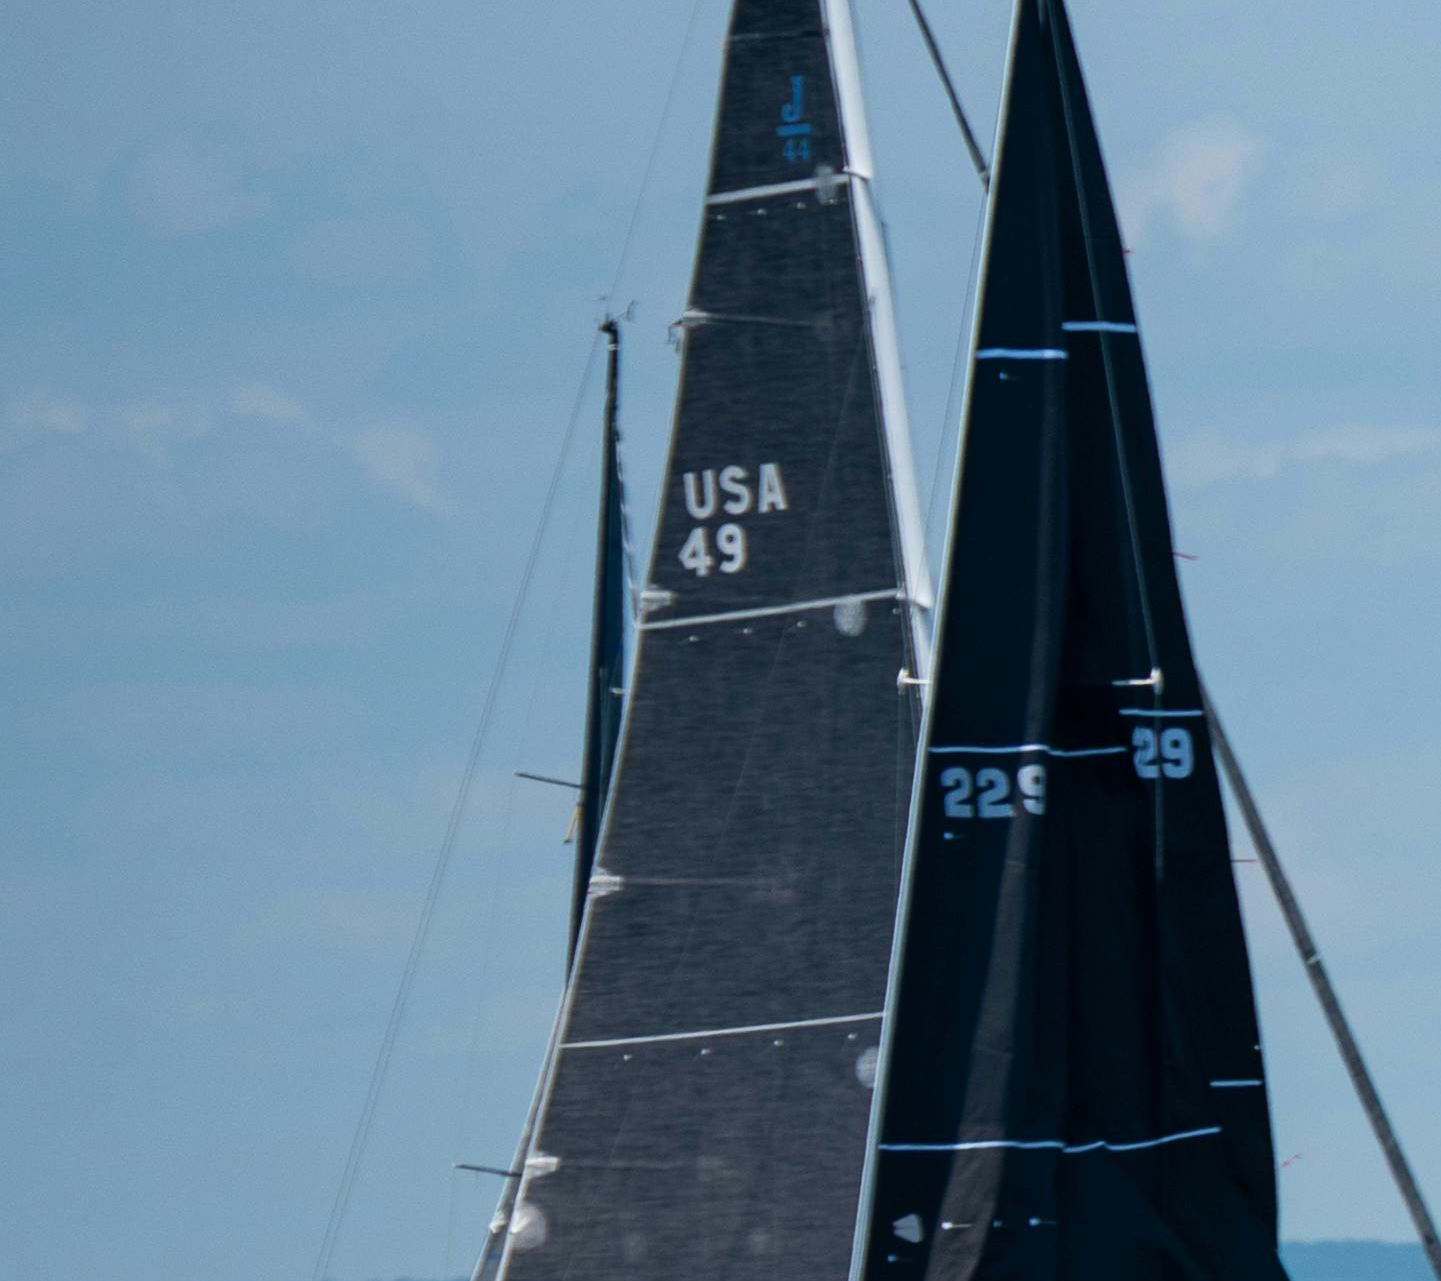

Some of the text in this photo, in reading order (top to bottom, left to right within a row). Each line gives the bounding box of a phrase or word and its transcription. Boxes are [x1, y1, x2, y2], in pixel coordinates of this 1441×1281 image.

[683, 463, 789, 520] USA
[678, 523, 748, 577] 49
[1131, 725, 1194, 780] 29
